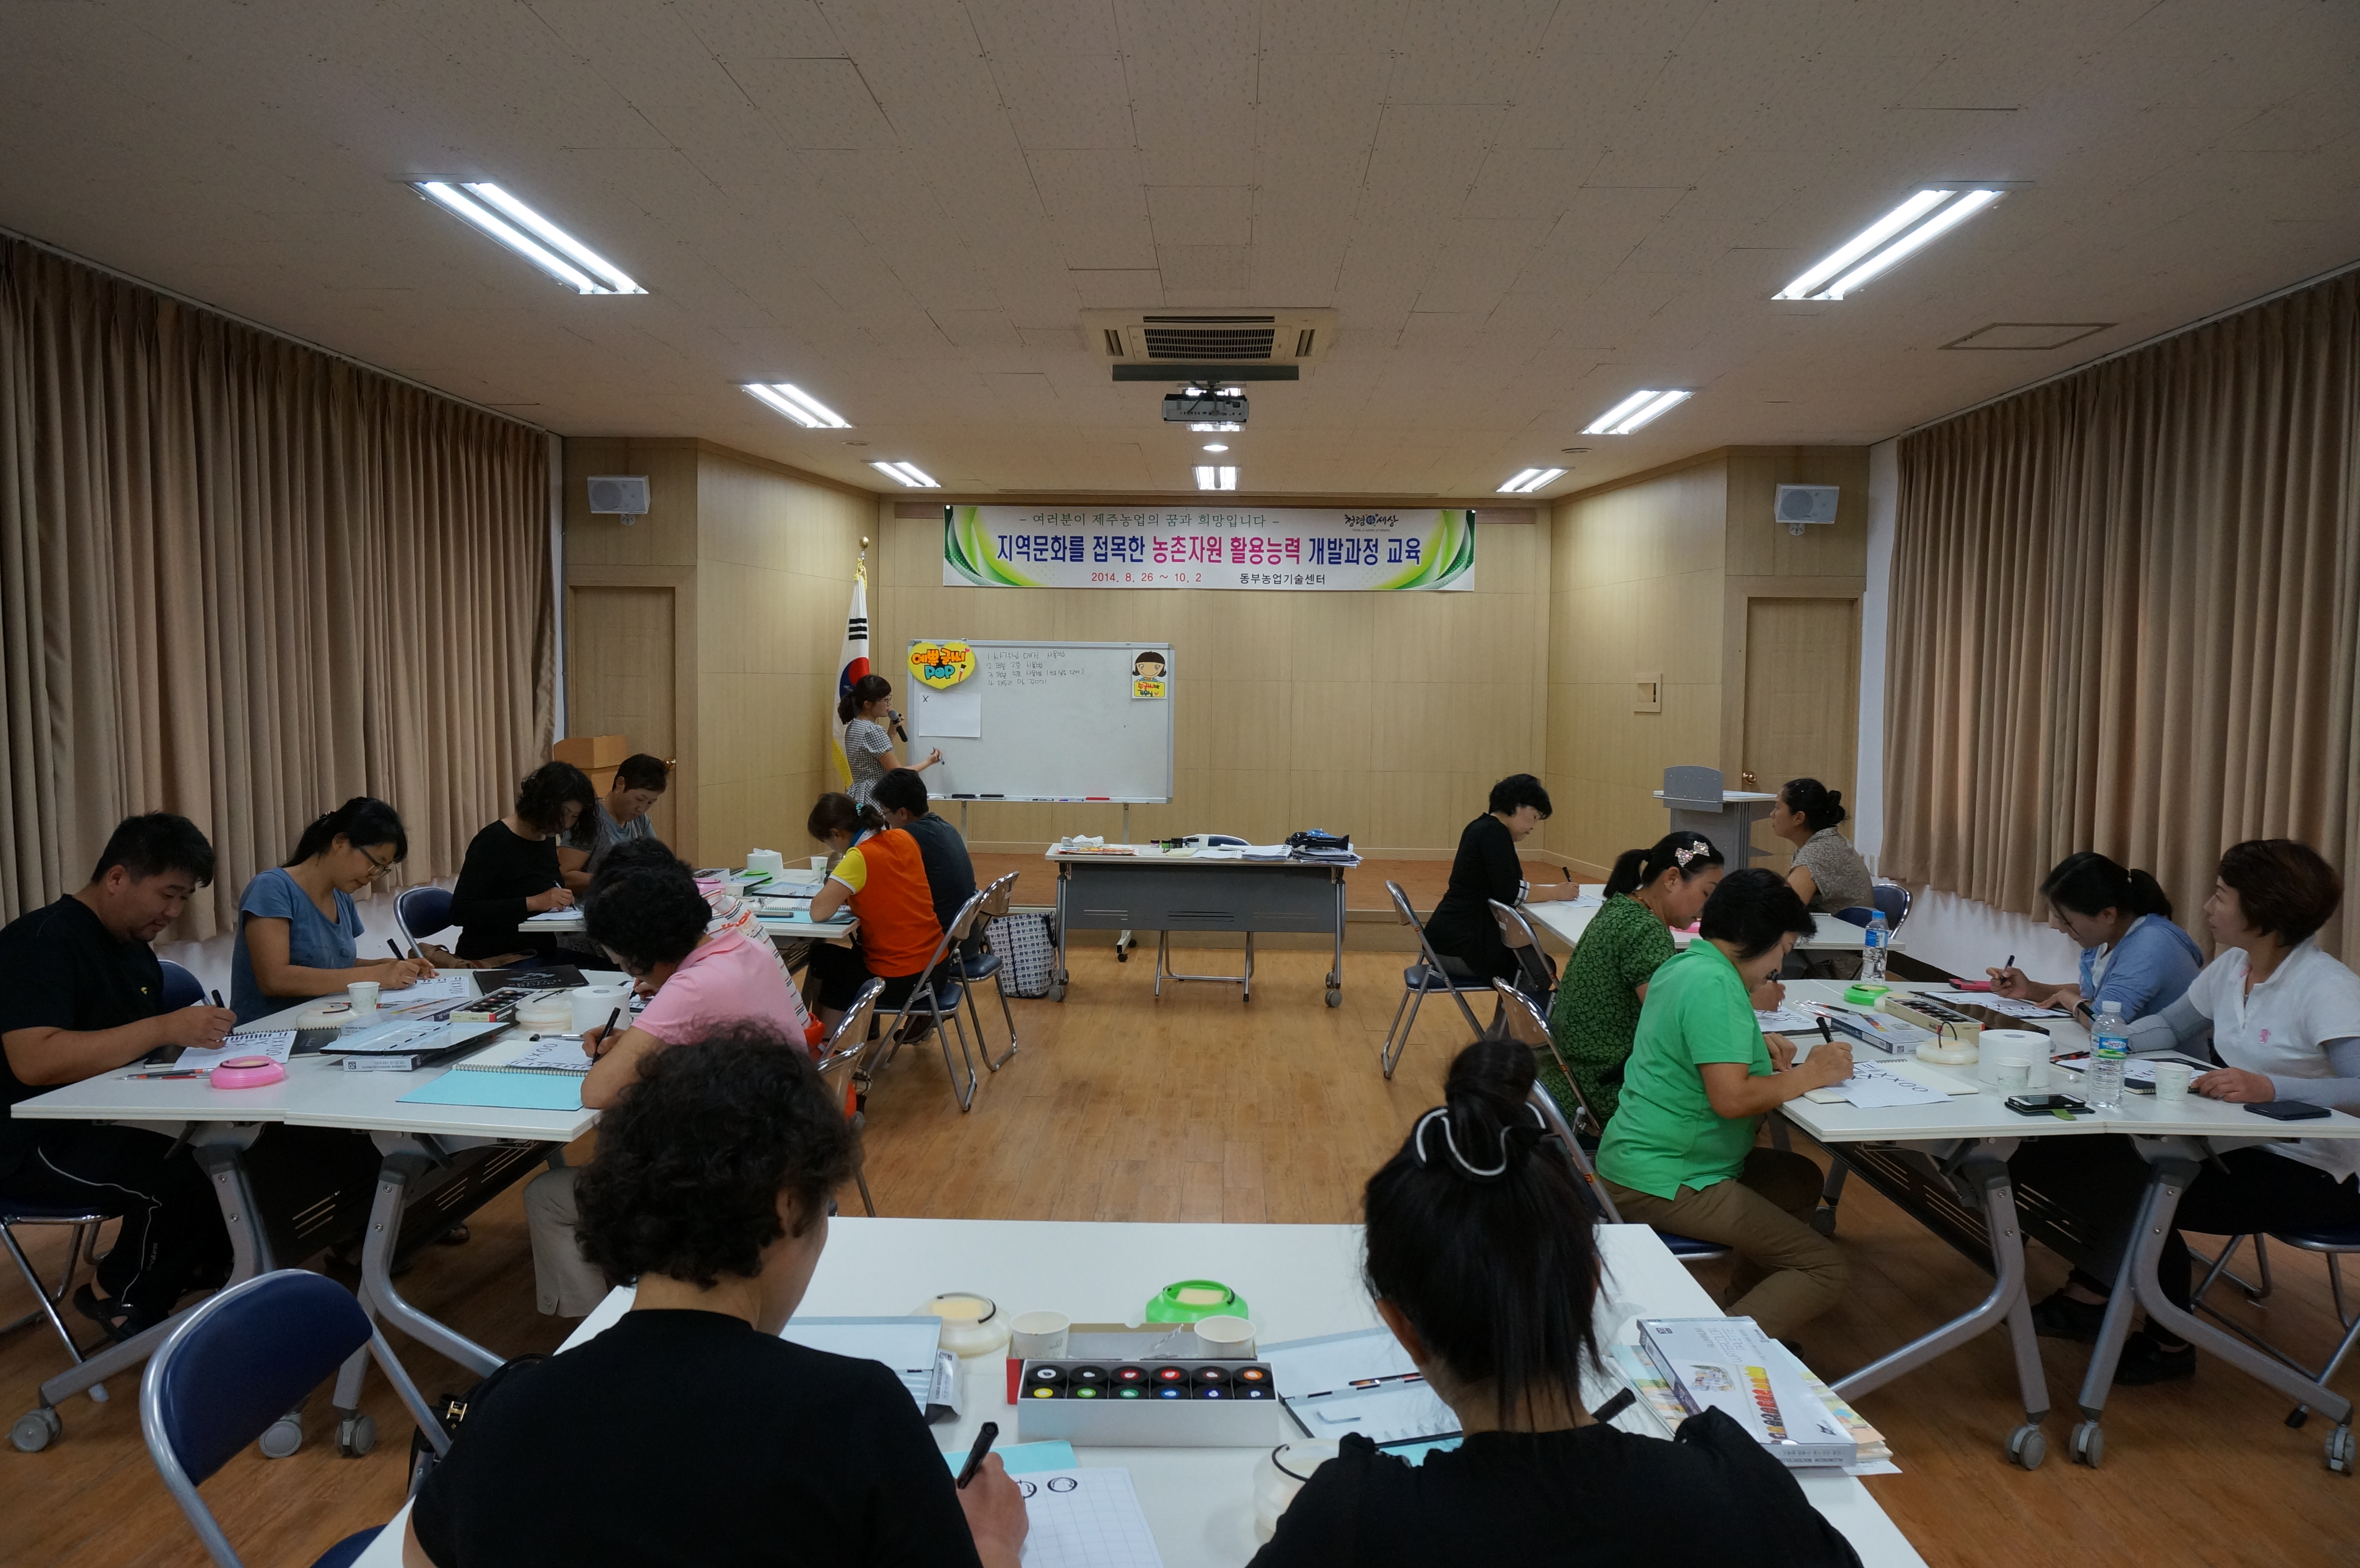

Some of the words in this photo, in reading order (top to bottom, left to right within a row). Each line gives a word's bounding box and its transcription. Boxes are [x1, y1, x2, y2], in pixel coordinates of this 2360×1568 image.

[1033, 513, 1086, 527] 여러분이
[1093, 513, 1159, 527] 제주농업의
[1166, 514, 1192, 528] 꿈과
[1198, 514, 1266, 528] 희망입니다
[997, 535, 1085, 562] 지역문화를
[1093, 535, 1145, 563] 접목한
[1152, 536, 1222, 564] 농촌자원
[1230, 537, 1301, 564] 활용능력
[1308, 538, 1378, 565] 개발과정
[1387, 538, 1421, 565] 교육
[1091, 573, 1119, 583] 2014.
[1125, 573, 1135, 583] 8.
[1141, 573, 1154, 582] 26
[1175, 573, 1189, 583] 10.
[1196, 573, 1202, 582] 2
[1240, 573, 1326, 585] 동부농업기술센터
[911, 649, 940, 666] 예쁜
[941, 648, 966, 665] 글씨
[1047, 650, 1066, 659] 사용법
[924, 664, 955, 680] POP
